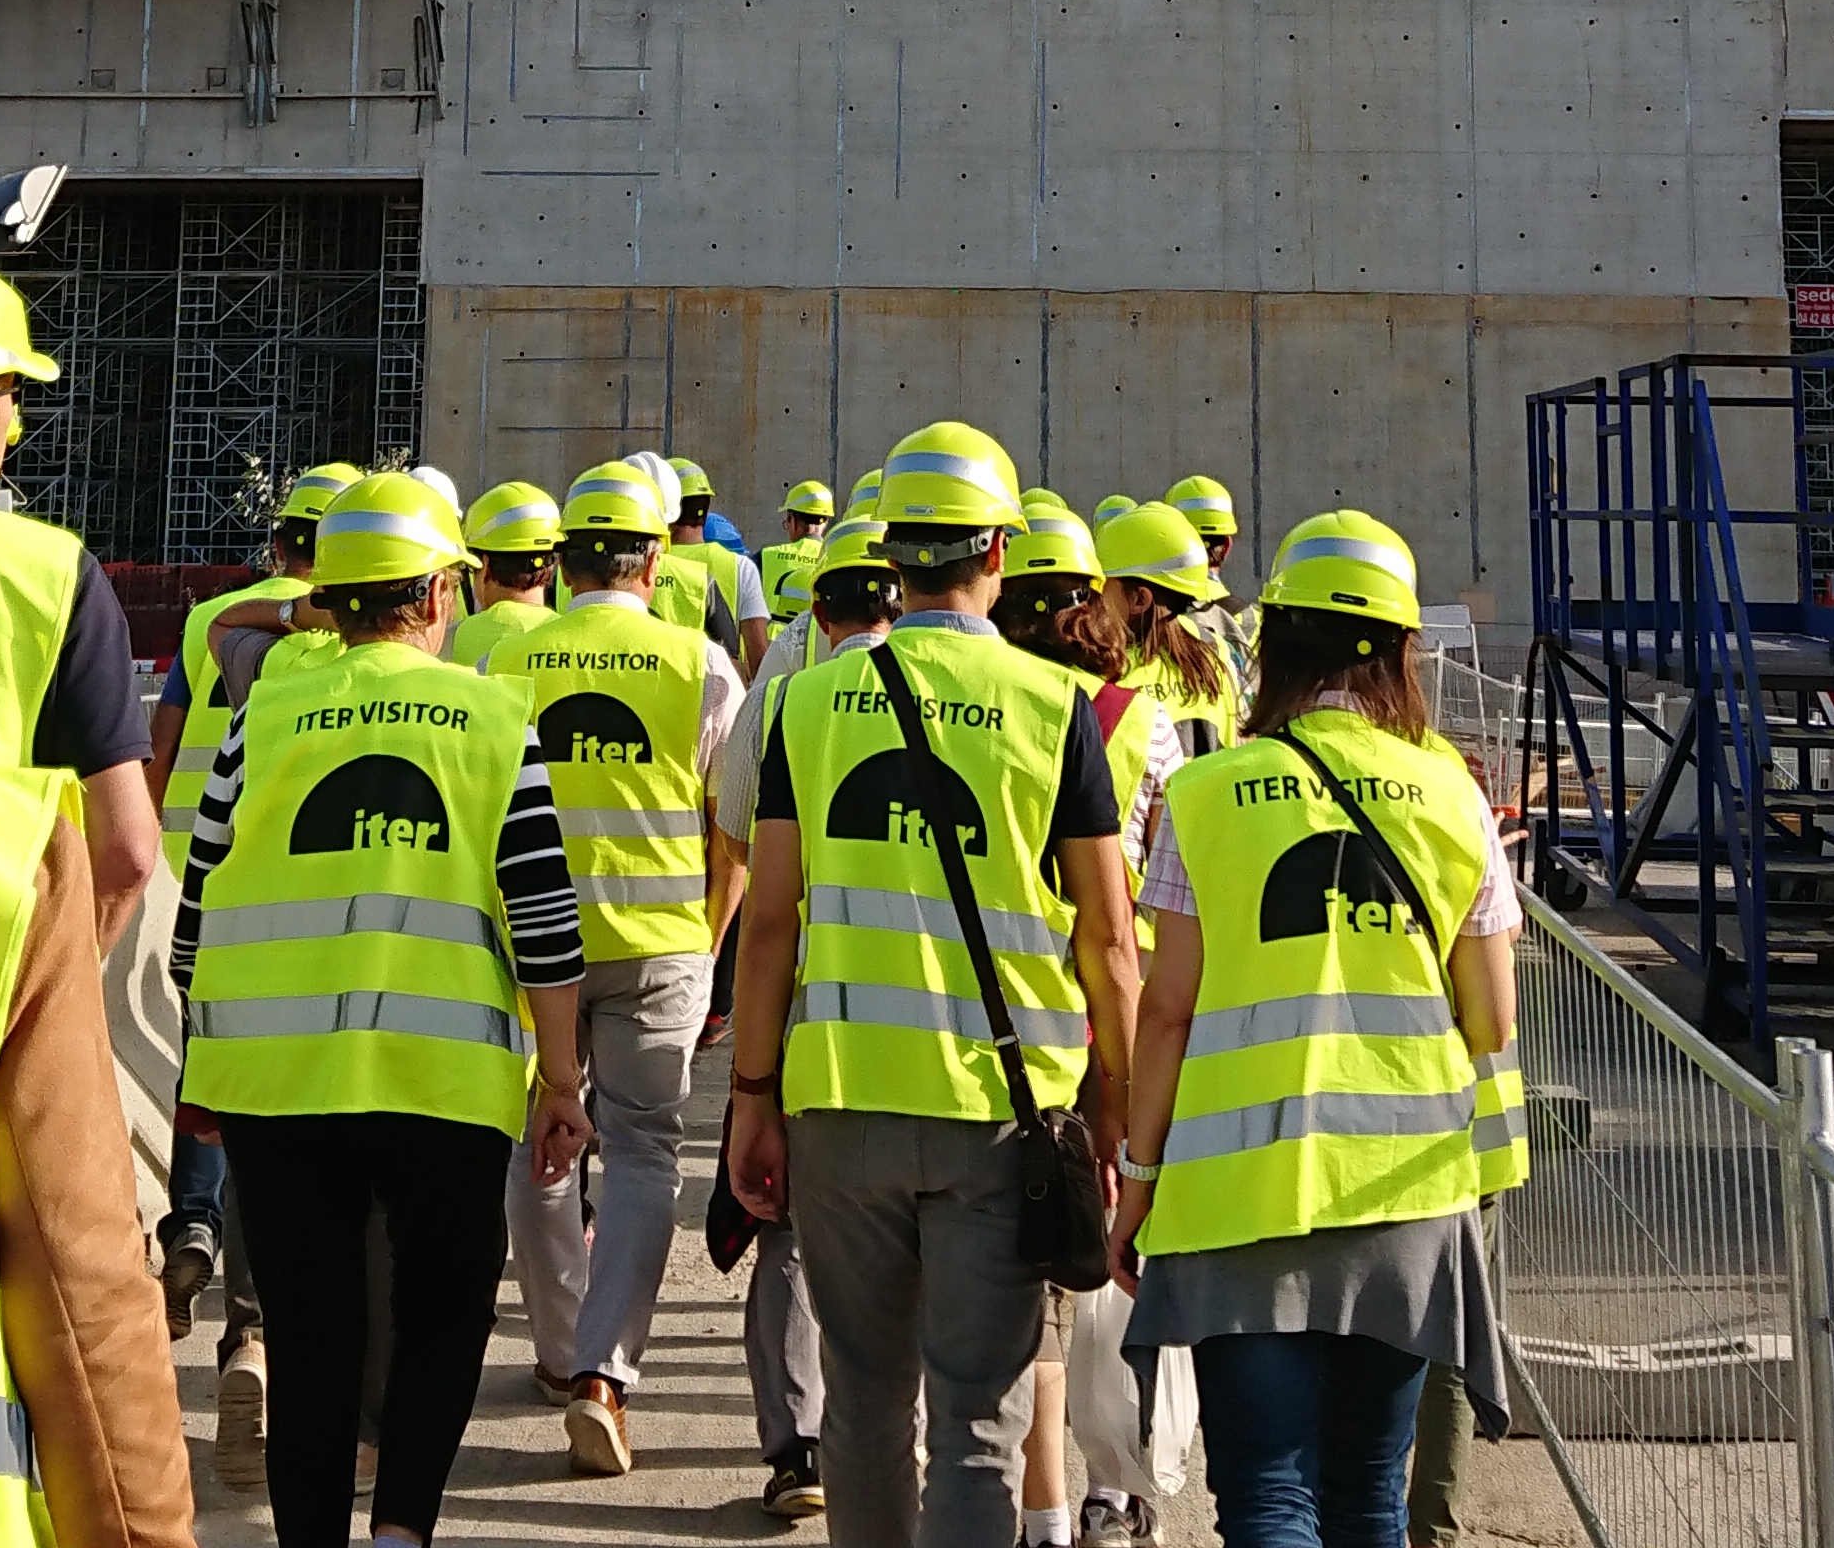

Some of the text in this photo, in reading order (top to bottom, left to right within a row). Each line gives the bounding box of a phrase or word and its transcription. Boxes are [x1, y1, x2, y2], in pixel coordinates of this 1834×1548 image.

[777, 552, 819, 565] ITER VISIT
[527, 652, 658, 671] ITER VISITOR
[295, 701, 468, 734] ITER VISITOR
[833, 691, 890, 714] ITER
[571, 732, 643, 764] iter
[1235, 775, 1301, 807] ITER
[352, 809, 440, 852] iter
[888, 801, 976, 854] itr
